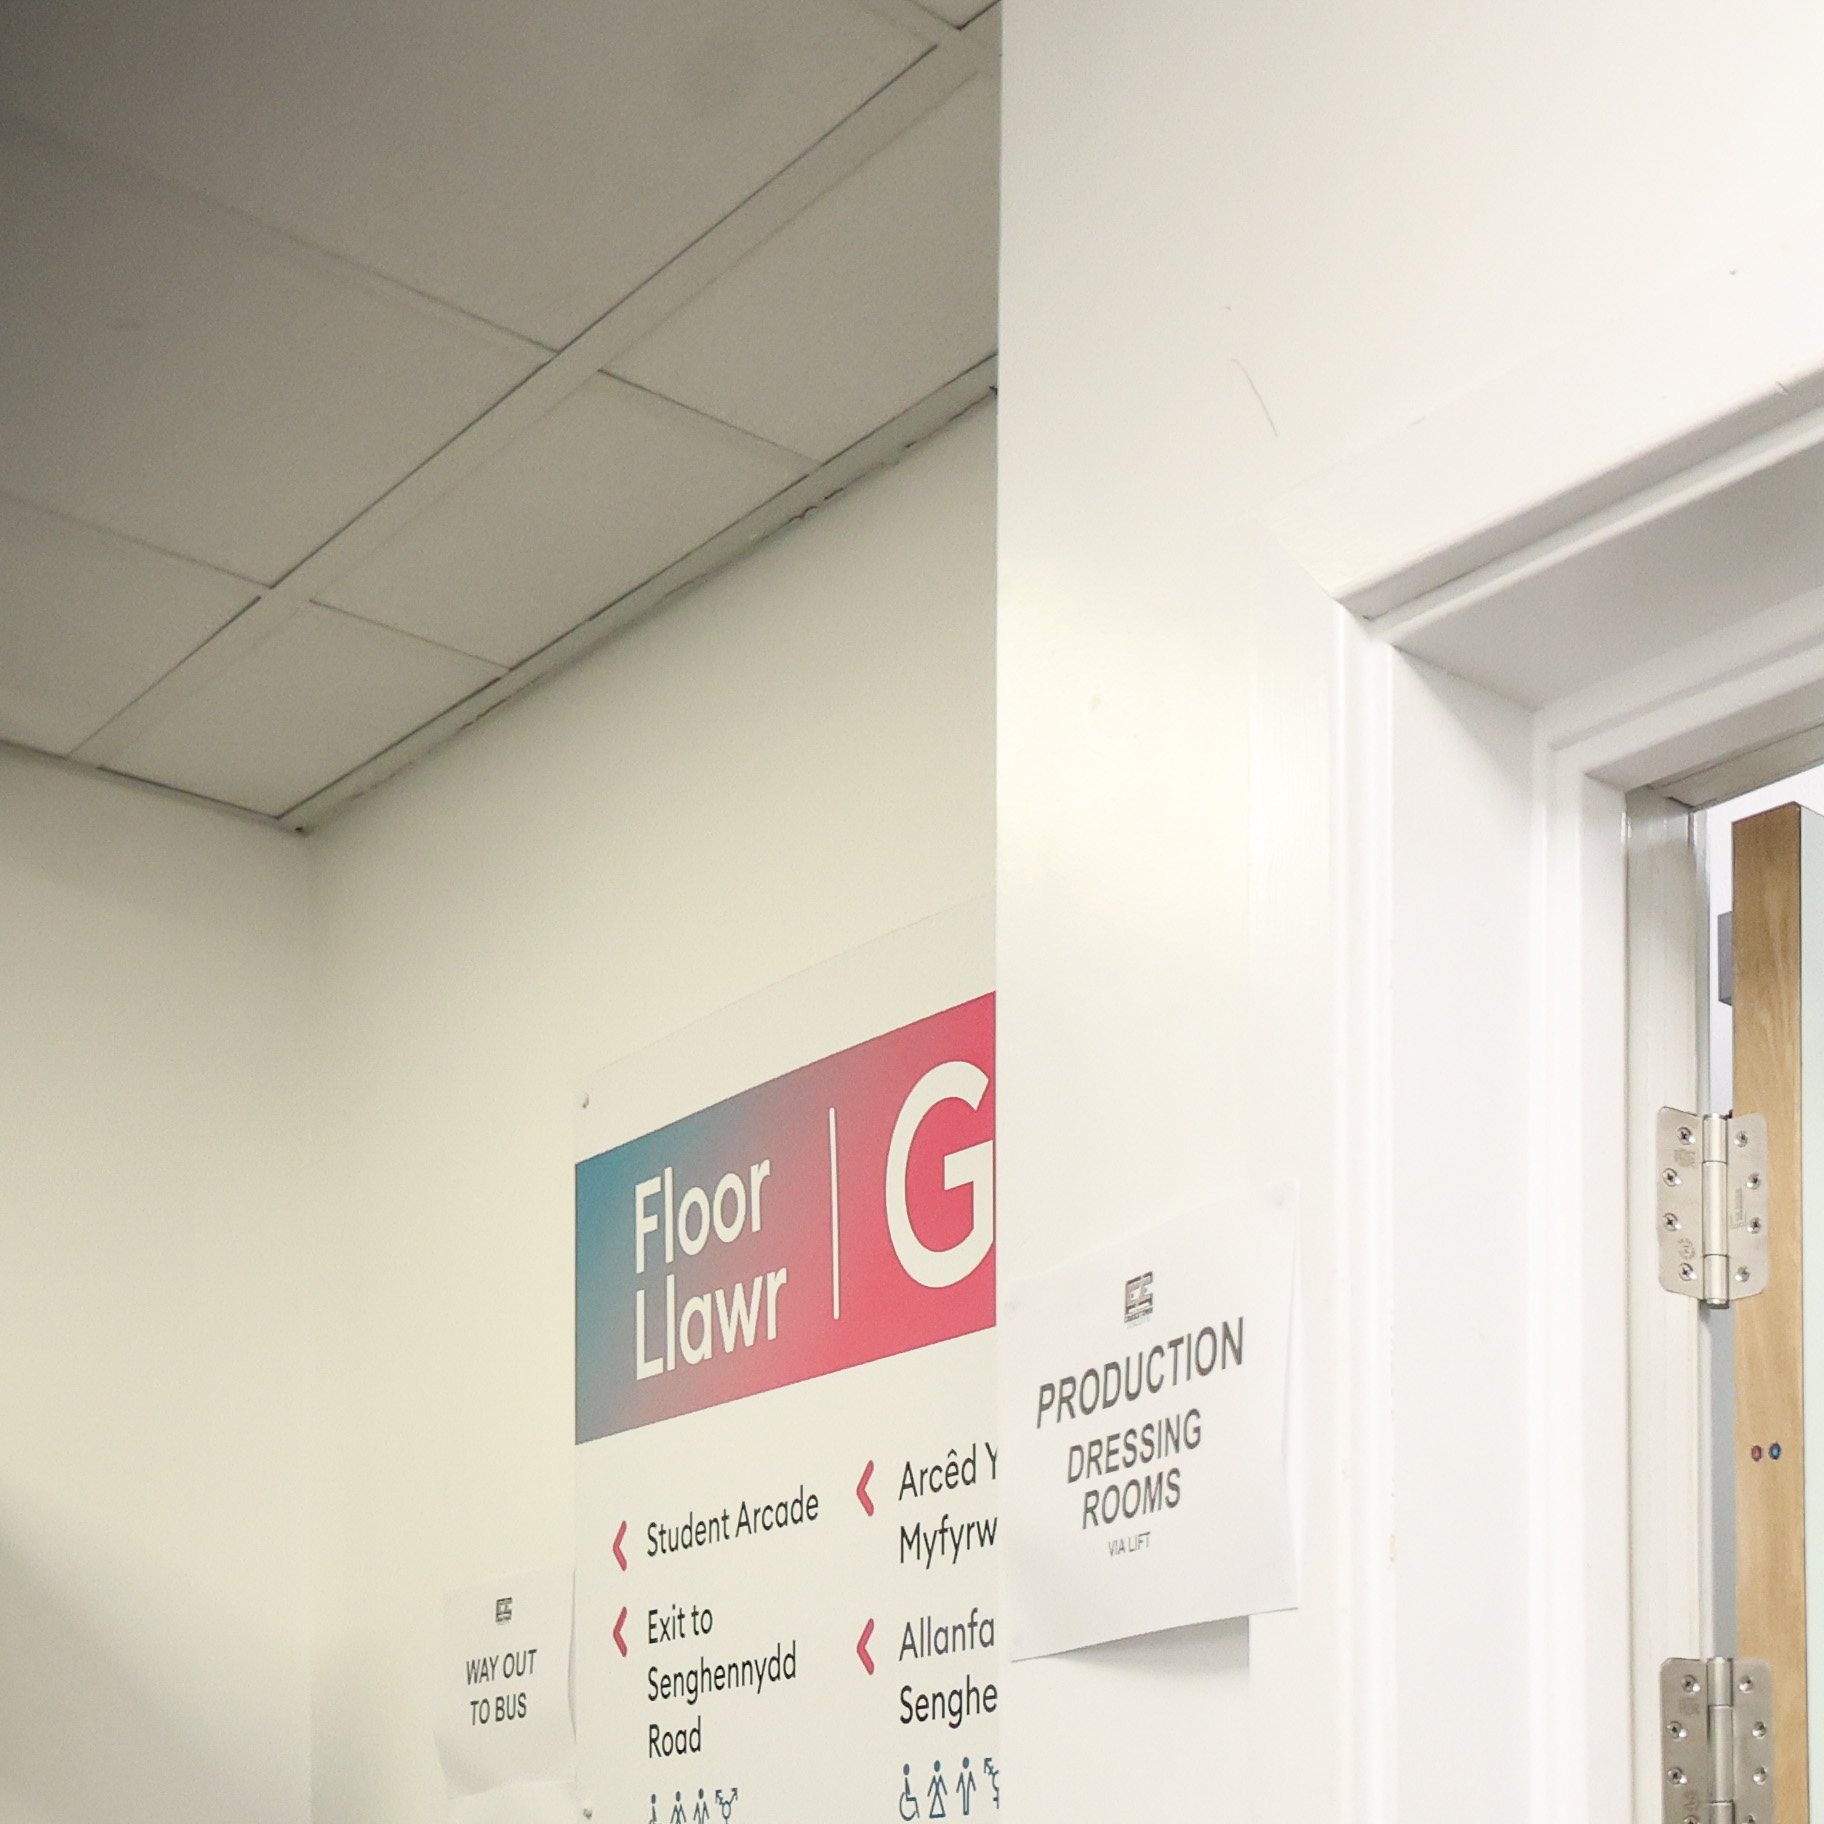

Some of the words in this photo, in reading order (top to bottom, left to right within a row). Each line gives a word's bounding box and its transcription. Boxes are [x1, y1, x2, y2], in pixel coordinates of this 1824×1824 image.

[886, 1060, 994, 1289] G
[634, 1159, 771, 1275] Floor
[634, 1266, 788, 1381] Llawr
[1036, 1316, 1244, 1429] PRODUCTION
[899, 1443, 978, 1502] Arcêd
[984, 1442, 998, 1481] Y
[1067, 1408, 1201, 1483] DRESSING
[647, 1506, 730, 1558] Student
[735, 1484, 820, 1537] Arcade
[1082, 1468, 1181, 1530] ROOMS
[1108, 1533, 1127, 1557] VIA
[1128, 1531, 1151, 1553] LIFT
[647, 1603, 687, 1645] Exit
[690, 1605, 715, 1638] to
[899, 1608, 996, 1663] Allanfa
[466, 1655, 499, 1685] WAY
[502, 1648, 538, 1679] OUT
[647, 1641, 798, 1706] Senghennydd
[470, 1698, 490, 1726] TO
[495, 1692, 527, 1723] BUS
[899, 1676, 998, 1730] Senghe
[648, 1716, 702, 1760] Road
